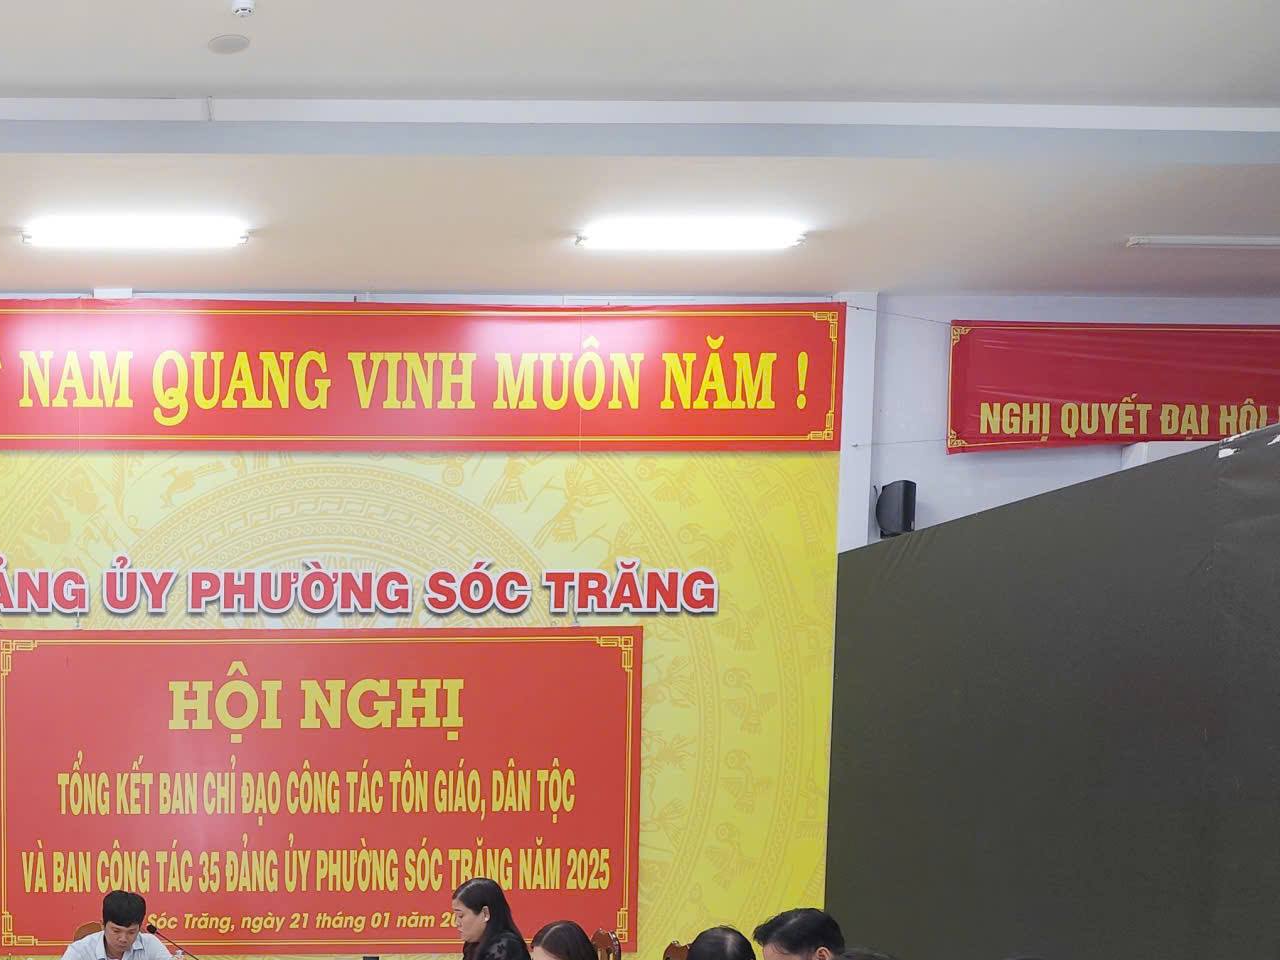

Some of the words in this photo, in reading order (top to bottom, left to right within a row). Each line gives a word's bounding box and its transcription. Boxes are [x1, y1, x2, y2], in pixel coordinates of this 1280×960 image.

[20, 350, 134, 408] NAM
[151, 350, 331, 427] QUANG
[347, 351, 477, 410] VINH
[493, 336, 645, 411] MUÔN
[661, 335, 776, 410] NĂM
[796, 351, 809, 410] !
[979, 402, 1051, 442] NGHỊ
[1061, 393, 1152, 439] QUYẾT
[1160, 403, 1210, 440] ĐẠI
[105, 555, 173, 610] ỦY
[190, 561, 410, 611] PHƯỜNG
[425, 561, 530, 611] SÓC
[545, 561, 716, 611] TRĂNG
[168, 661, 283, 744] HỘI
[300, 678, 465, 741] NGHỊ
[57, 751, 110, 816] TỔNG
[116, 755, 153, 815] KẾT
[159, 772, 198, 815] BAN
[203, 755, 236, 815] CHỈ
[240, 771, 281, 826] ĐẠO
[286, 759, 340, 815] CÔNG
[346, 759, 384, 813] TÁC
[389, 758, 429, 813] TÔN
[434, 758, 486, 821] GIÁO,
[492, 758, 531, 813] DÂN
[537, 757, 575, 823] TỘC
[21, 840, 48, 893] VÀ
[53, 851, 91, 893] BAN
[96, 839, 150, 893] CÔNG
[155, 839, 193, 893] TÁC
[198, 851, 220, 893] 35
[225, 833, 278, 892] ĐẢNG
[284, 833, 310, 892] ỦY
[316, 837, 399, 893] PHƯỜNG
[404, 837, 443, 892] SÓC
[448, 837, 513, 890] TRĂNG
[519, 837, 561, 890] NĂM
[566, 848, 610, 890] 2025
[147, 912, 178, 929] Sóc
[184, 913, 235, 934] Trăng,
[240, 912, 285, 933] ngày
[289, 912, 309, 929] 21
[315, 911, 366, 933] tháng
[370, 911, 391, 928] 01
[396, 911, 436, 928] năm
[440, 911, 458, 928] 20
